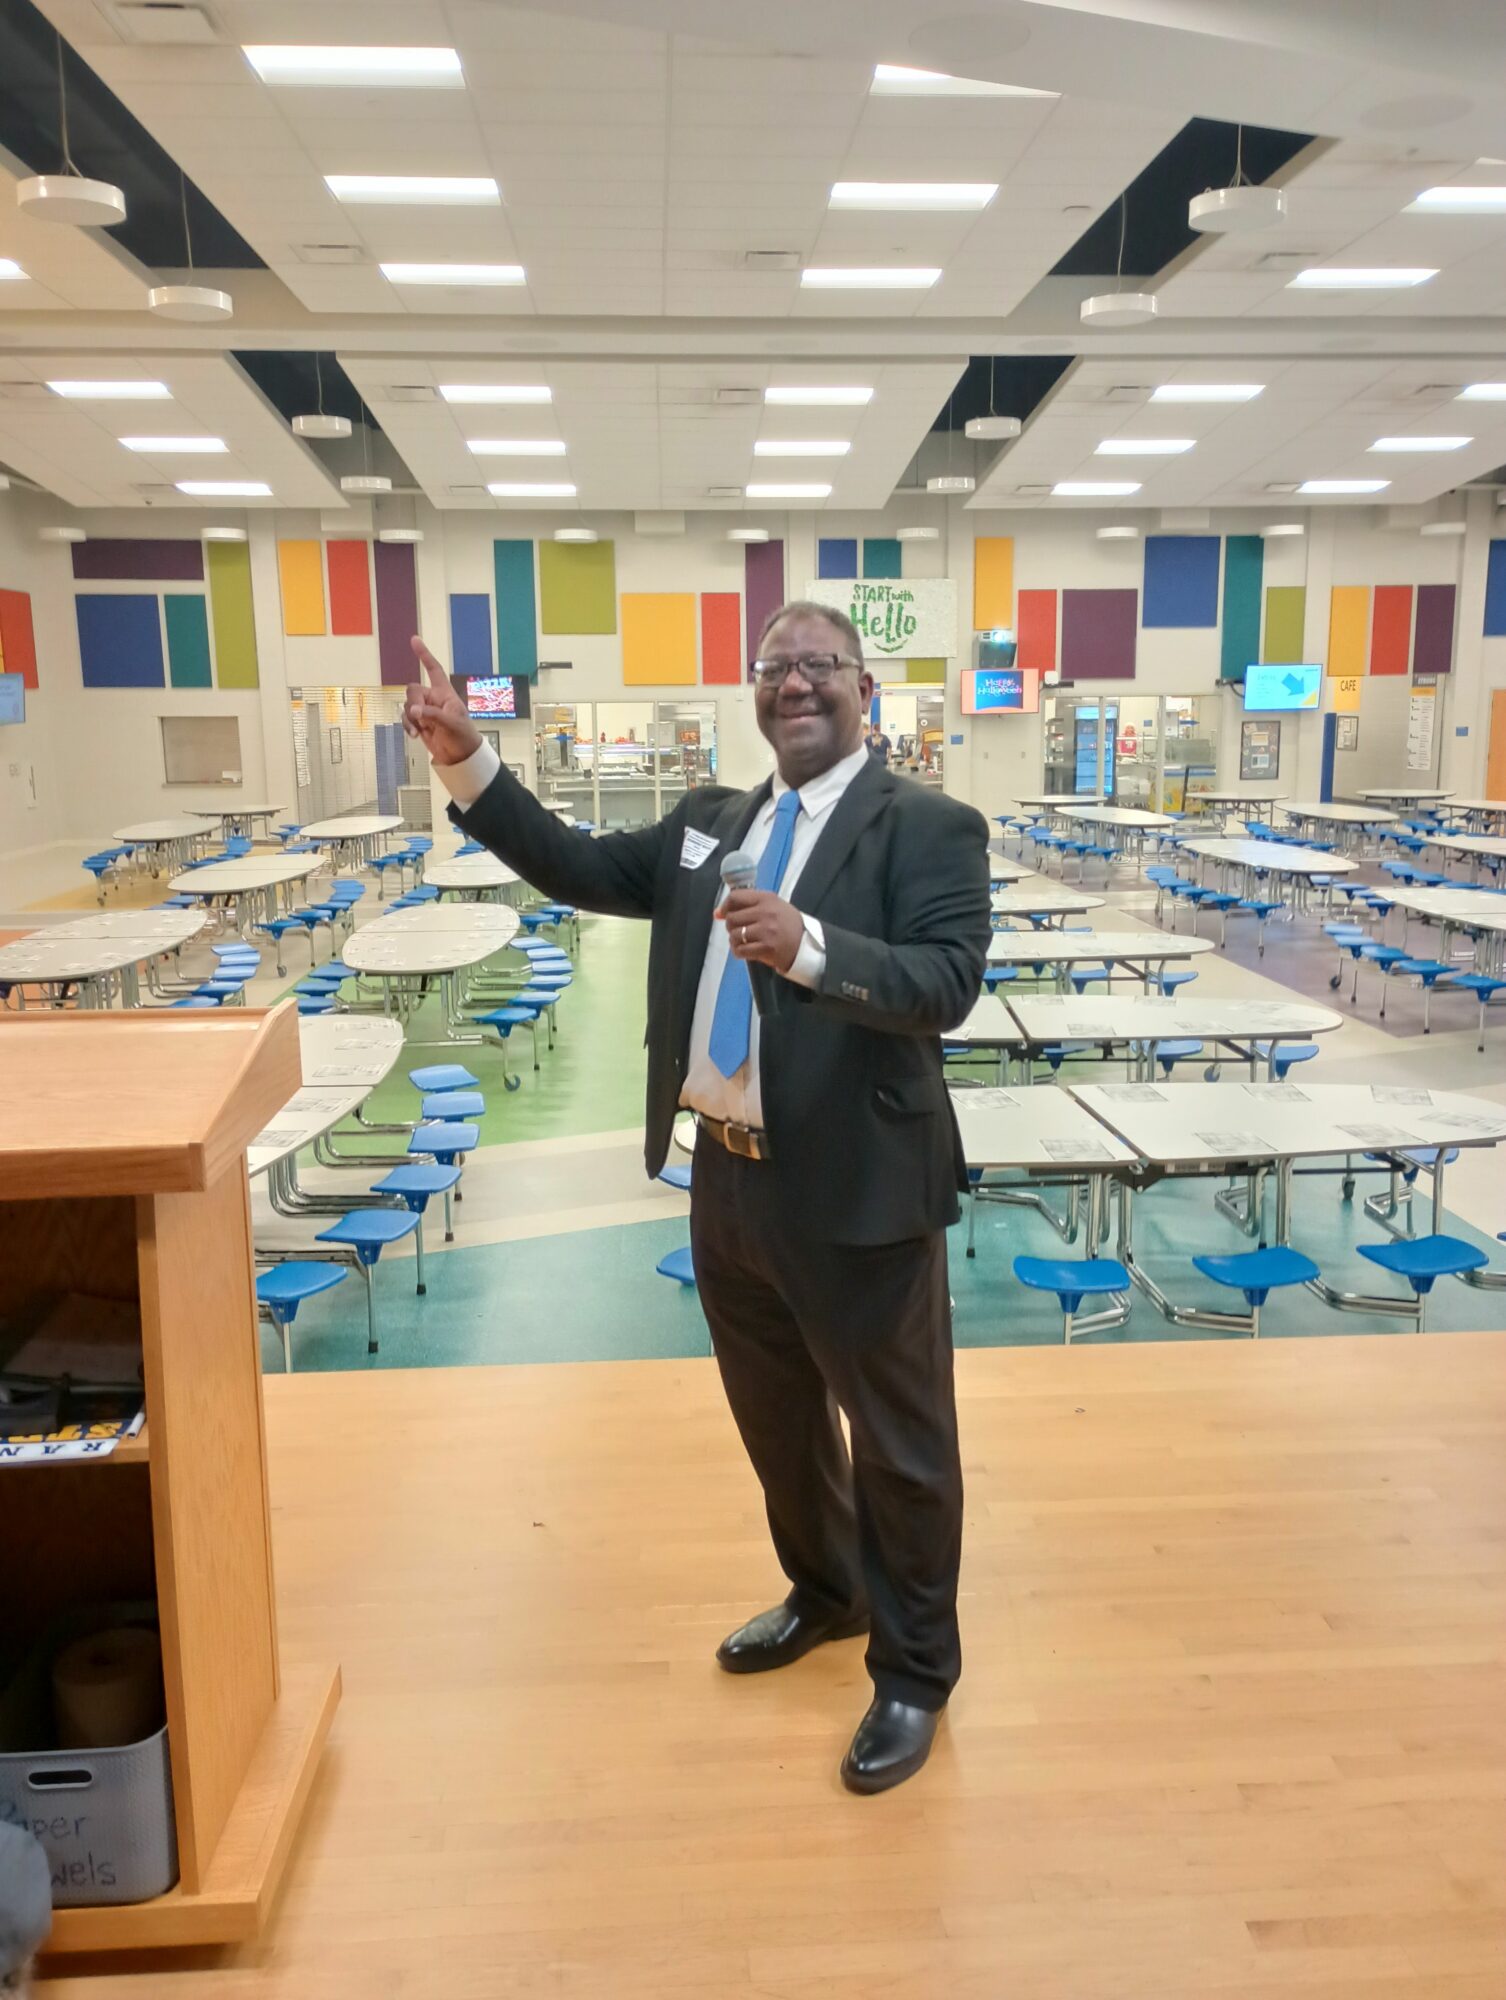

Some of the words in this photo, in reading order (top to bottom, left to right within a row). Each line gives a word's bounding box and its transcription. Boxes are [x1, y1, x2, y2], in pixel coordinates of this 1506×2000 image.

[853, 584, 892, 602] START
[892, 589, 914, 602] with
[850, 602, 917, 643] Hello
[1340, 680, 1357, 691] CAFE
[51, 1851, 117, 1887] wels
